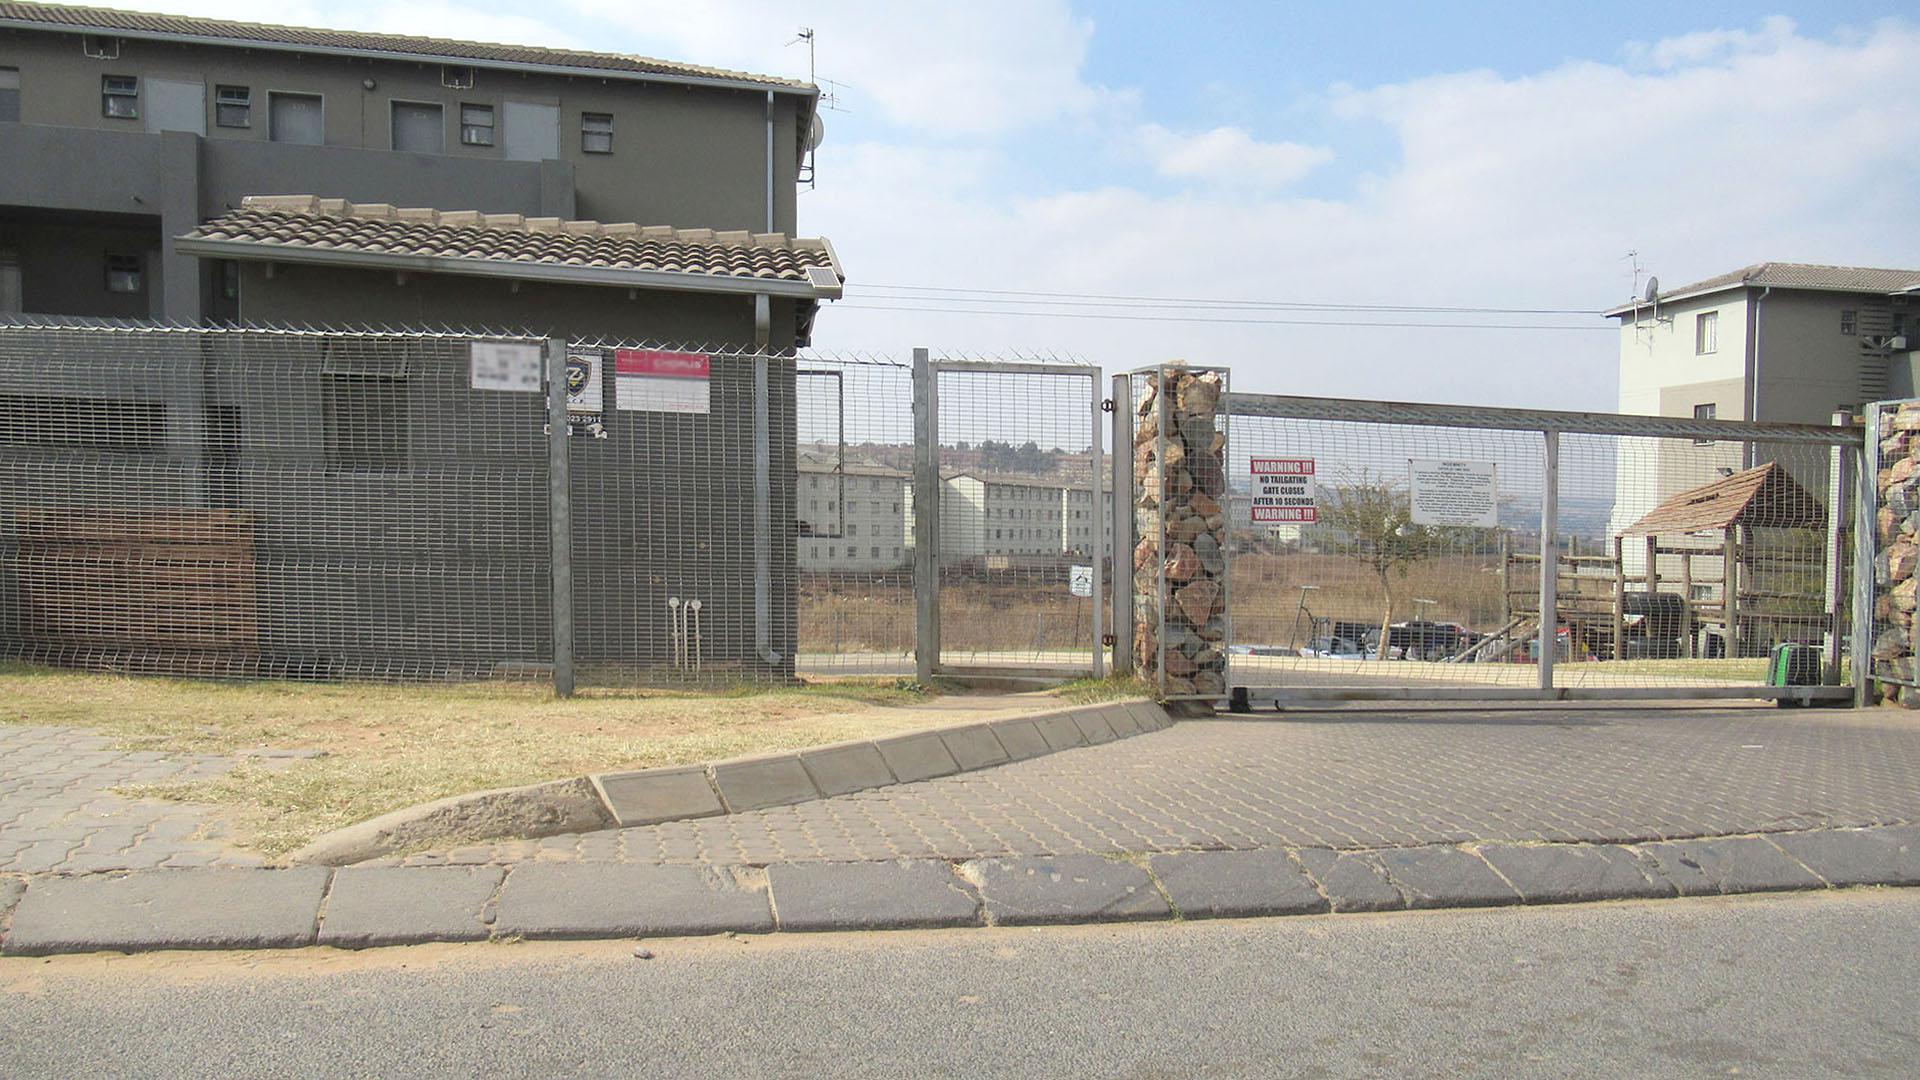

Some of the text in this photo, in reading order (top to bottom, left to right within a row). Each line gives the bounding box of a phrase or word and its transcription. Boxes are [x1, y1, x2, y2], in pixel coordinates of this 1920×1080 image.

[1253, 461, 1313, 473] WARNING !!!
[1260, 476, 1307, 484] NO TAILGATING
[1263, 486, 1304, 495] GATE CLOSES
[1254, 497, 1314, 506] AFTER 10 SECONDS
[1254, 508, 1314, 520] WARNING !!!
